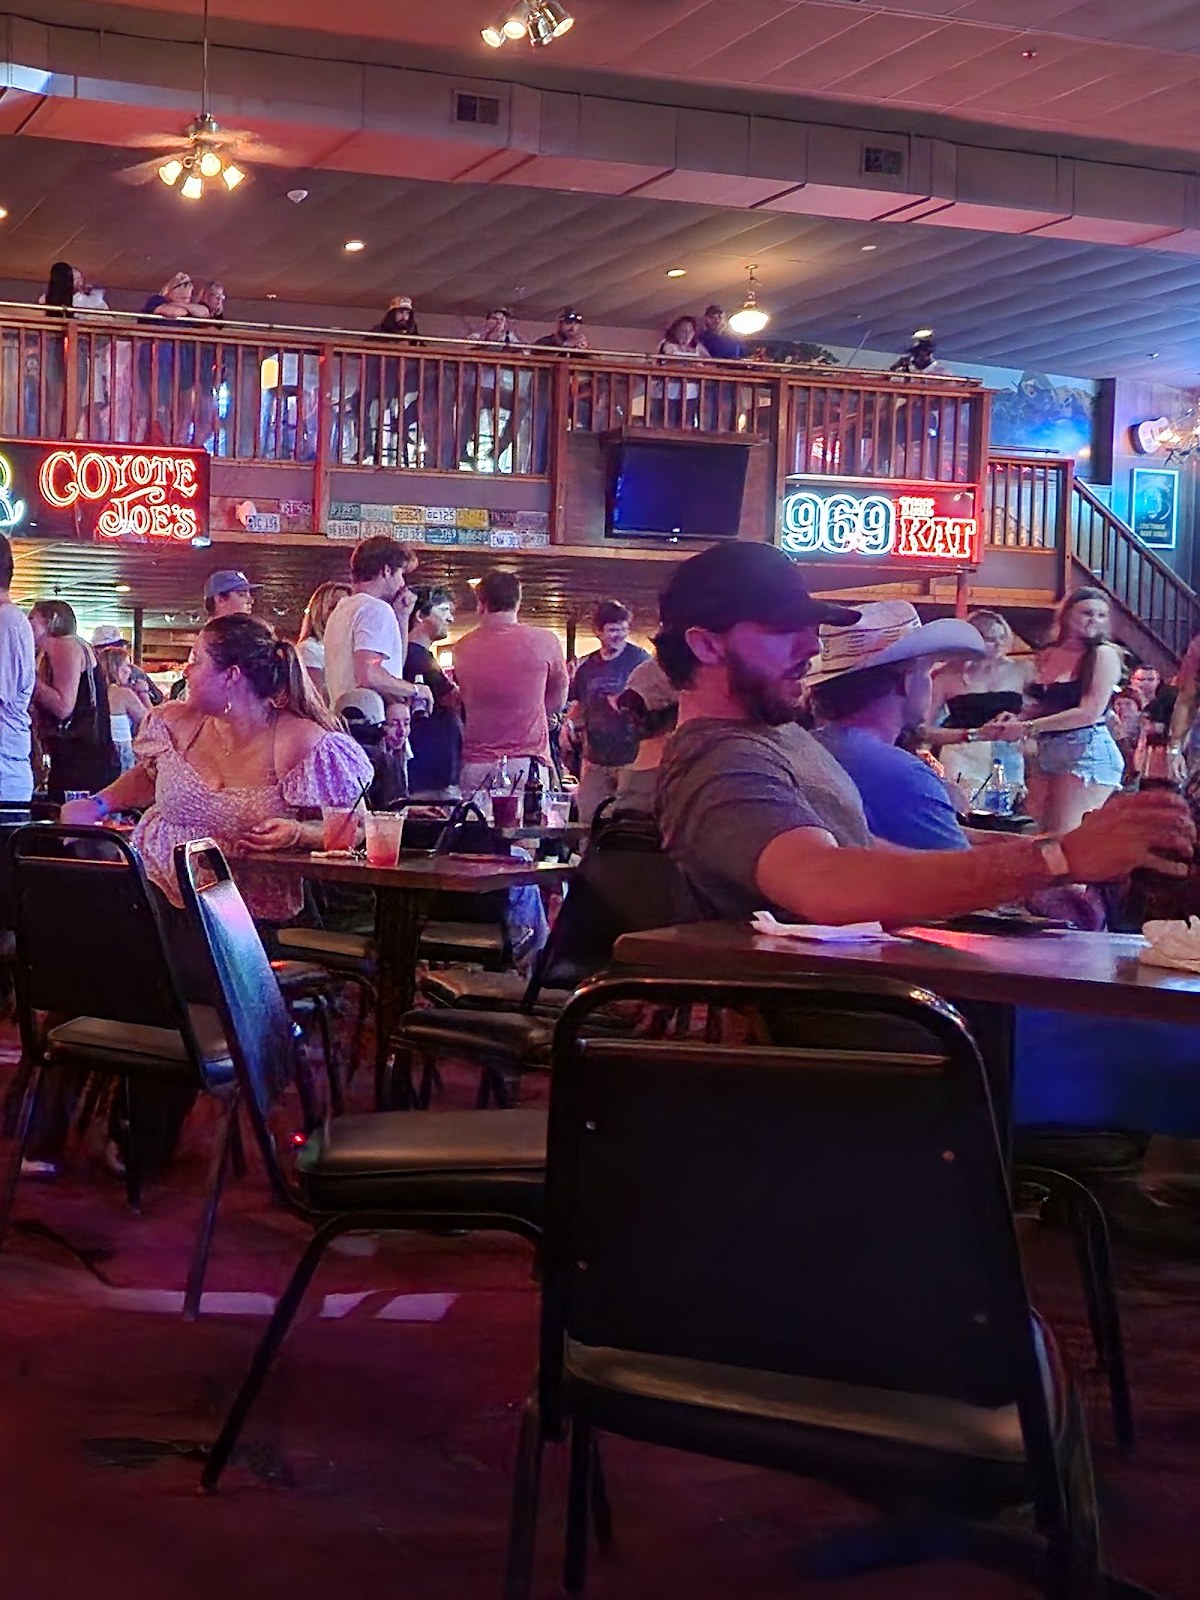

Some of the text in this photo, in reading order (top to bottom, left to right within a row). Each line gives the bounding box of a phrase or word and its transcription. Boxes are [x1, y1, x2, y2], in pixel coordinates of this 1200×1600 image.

[38, 451, 198, 507] COYOTE
[98, 486, 198, 539] JOE'S
[781, 492, 896, 555] 969
[899, 496, 936, 517] THE
[899, 516, 977, 558] KAT
